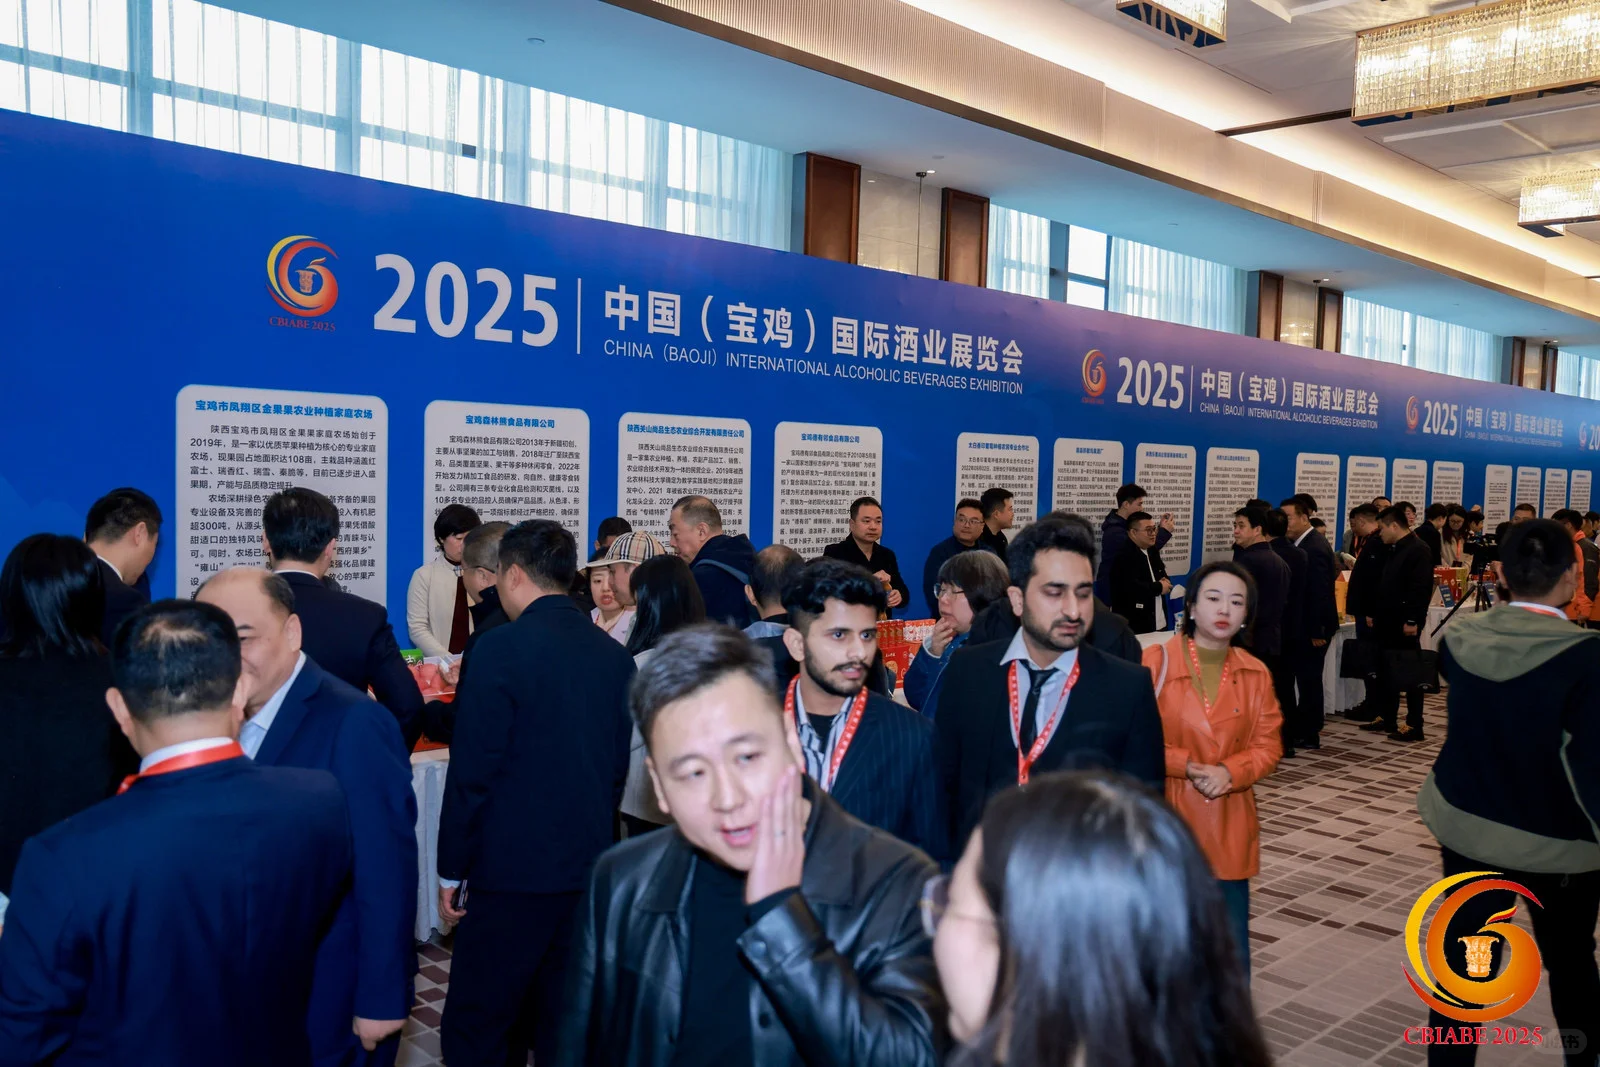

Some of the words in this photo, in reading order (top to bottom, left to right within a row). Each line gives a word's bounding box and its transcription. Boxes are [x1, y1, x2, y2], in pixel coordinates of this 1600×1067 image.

[374, 253, 559, 347] 2025
[269, 317, 310, 331] CBIABE
[311, 319, 336, 333] 2025
[604, 285, 1024, 375] 中国（宝鸡）国际酒业展览会
[603, 340, 654, 360] CHINA
[726, 352, 831, 377] INTERNATIONAL
[834, 364, 900, 384] ALCOHOLIC
[903, 370, 967, 391] BEVERAGES
[970, 377, 1024, 395] EXHIBITION
[1117, 356, 1184, 410] 2025
[196, 400, 373, 419] 宝鸡市凤翔区金果果农业种植家庭农场
[1201, 367, 1379, 416] 中国（宝鸡）国际酒业展览会
[211, 425, 376, 440] 陕西宝鸡市凤翔区金果果家庭农场始创于
[465, 415, 555, 428] 宝鸡森林熊食品有限公司
[1200, 403, 1220, 414] CHINA
[1248, 407, 1291, 421] INTERNATIONAL
[1292, 412, 1322, 425] ALCOHOLIC
[1322, 415, 1352, 428] BEVERAGES
[1353, 417, 1378, 430] EXHIBITION
[1423, 400, 1458, 437] 2025
